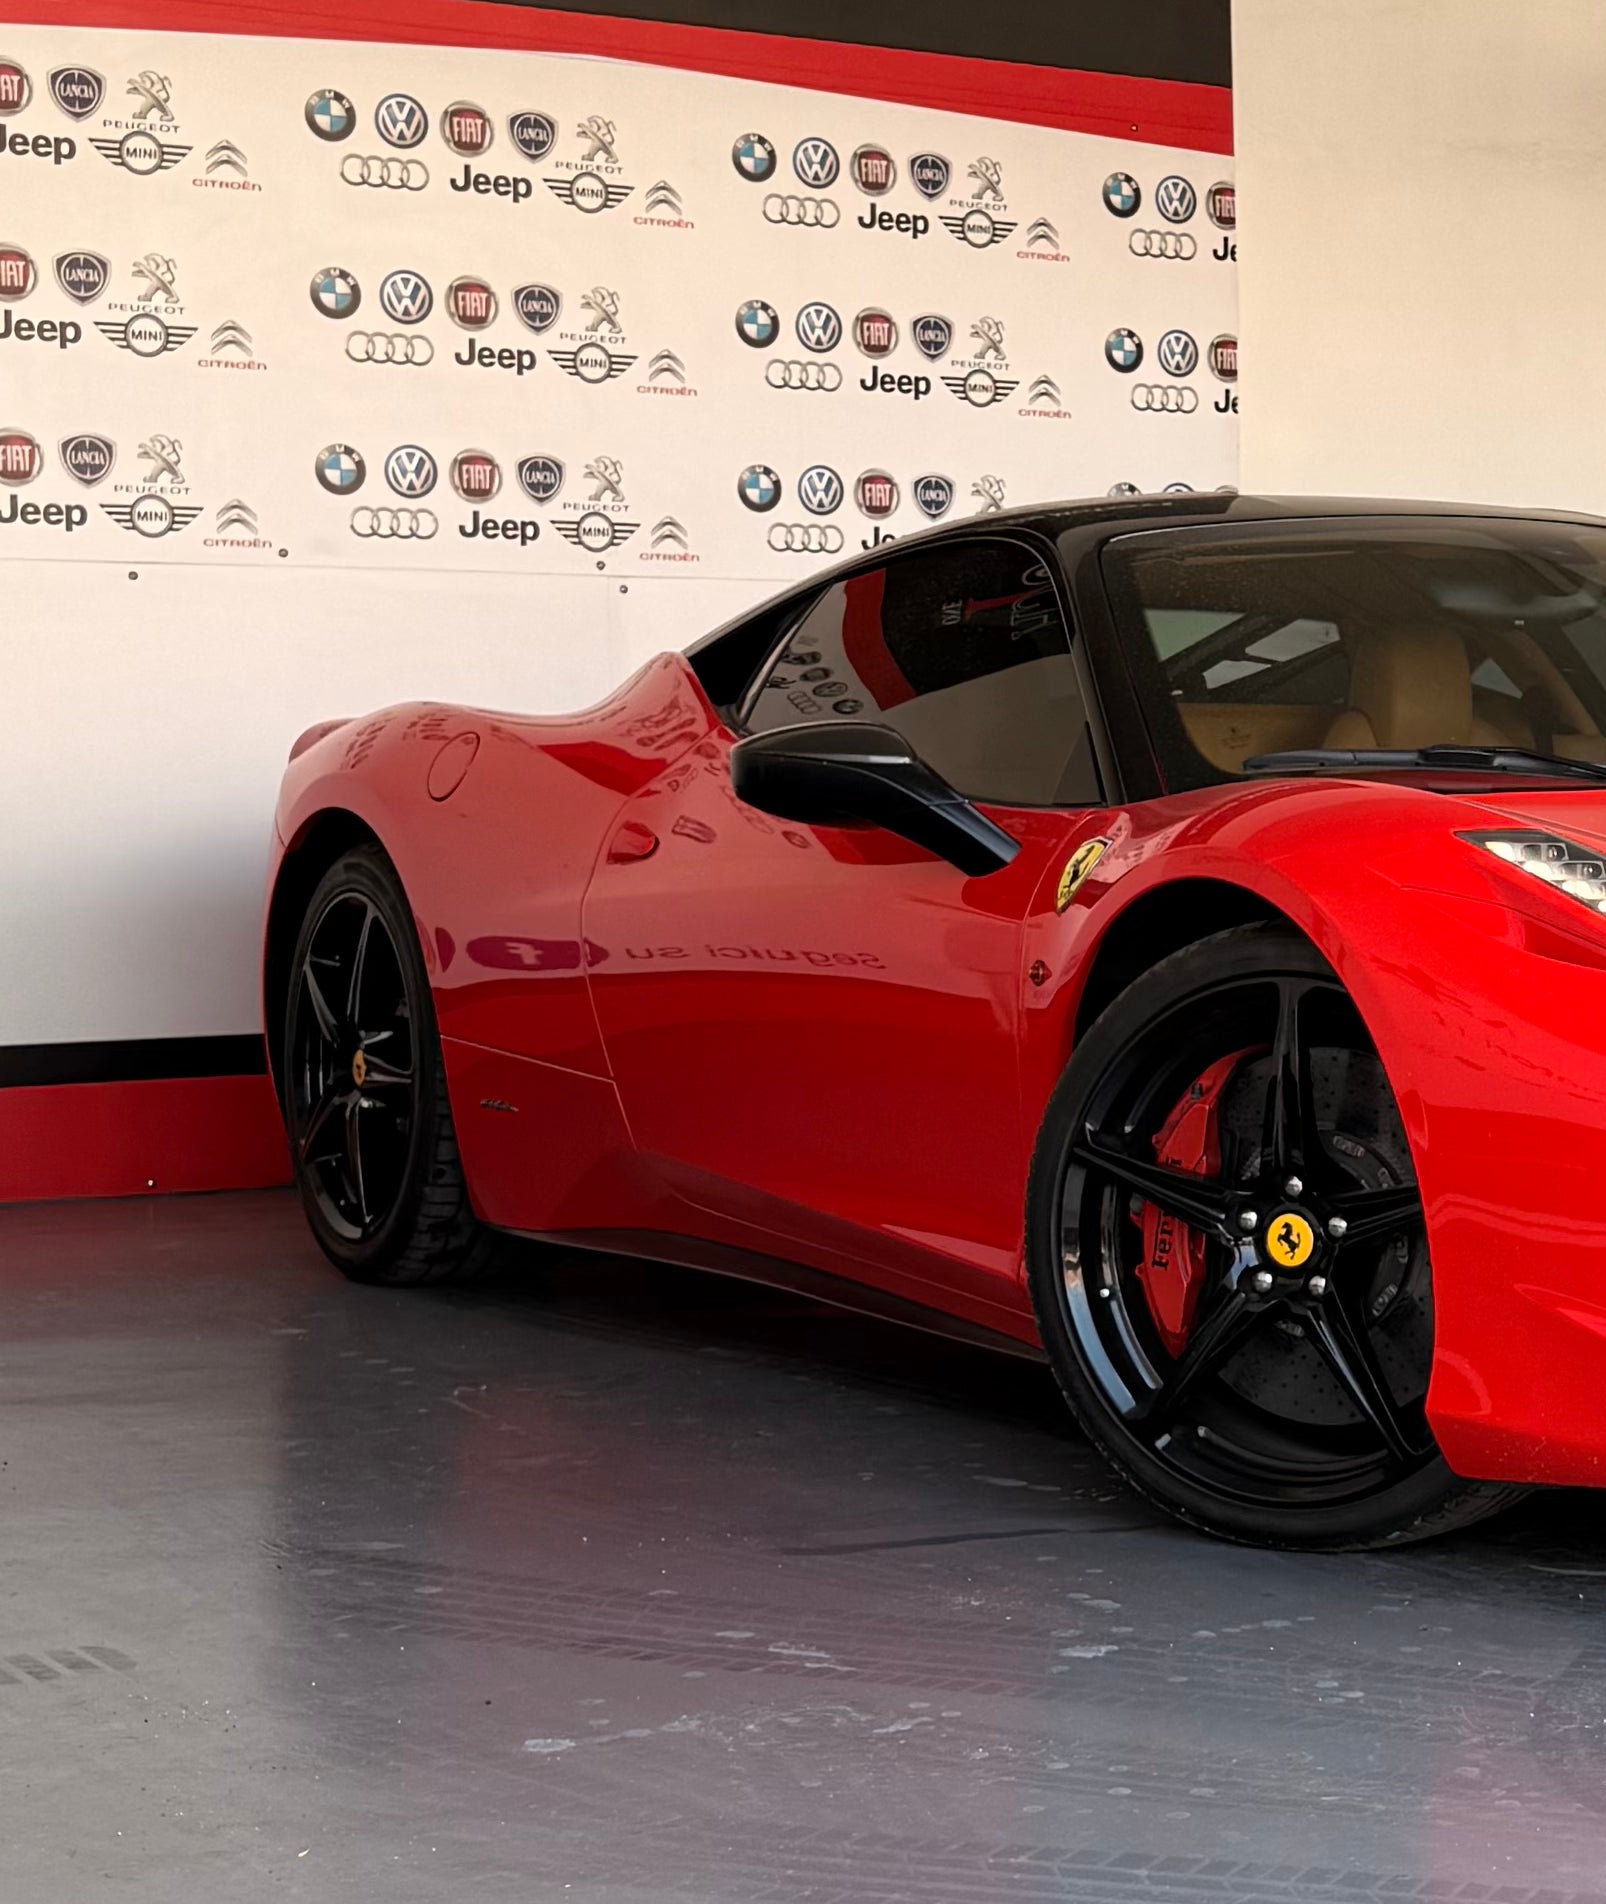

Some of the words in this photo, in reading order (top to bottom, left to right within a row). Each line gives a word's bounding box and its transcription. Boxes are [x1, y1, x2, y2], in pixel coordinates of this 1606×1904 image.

[0, 74, 20, 101] AT
[103, 119, 181, 134] PEUGEOT
[452, 116, 483, 143] FIAT
[126, 147, 158, 160] MINI
[555, 160, 624, 175] PEUGEOT
[860, 158, 888, 183] FIAT
[450, 164, 533, 203] Jeep
[576, 187, 603, 199] MINI
[950, 198, 1008, 212] PEUGEOT
[1215, 195, 1236, 217] FIA
[857, 202, 930, 239] Jeep
[966, 223, 991, 235] MINI
[0, 260, 26, 287] IAT
[66, 267, 98, 283] LANCIA
[108, 303, 186, 315] PEUGEOT
[457, 291, 489, 317] FIAT
[0, 308, 82, 349] Jeep
[131, 328, 162, 342] MINI
[862, 321, 890, 346] FIAT
[559, 332, 626, 344] PEUGEOT
[454, 338, 537, 375] Jeep
[579, 358, 607, 369] MINI
[1217, 348, 1238, 370] FIA
[950, 360, 1010, 371] PEUGEOT
[859, 365, 932, 400] Jeep
[968, 382, 993, 393] MINI
[71, 449, 105, 465] LANCIA
[461, 464, 493, 489] FIAT
[114, 484, 192, 495] PEUGEOT
[864, 483, 891, 507] FIAT
[0, 494, 88, 532] Jeep
[563, 502, 630, 512] PEUGEOT
[137, 510, 168, 522] MINI
[458, 510, 541, 547] Jeep
[582, 526, 609, 538] MINI
